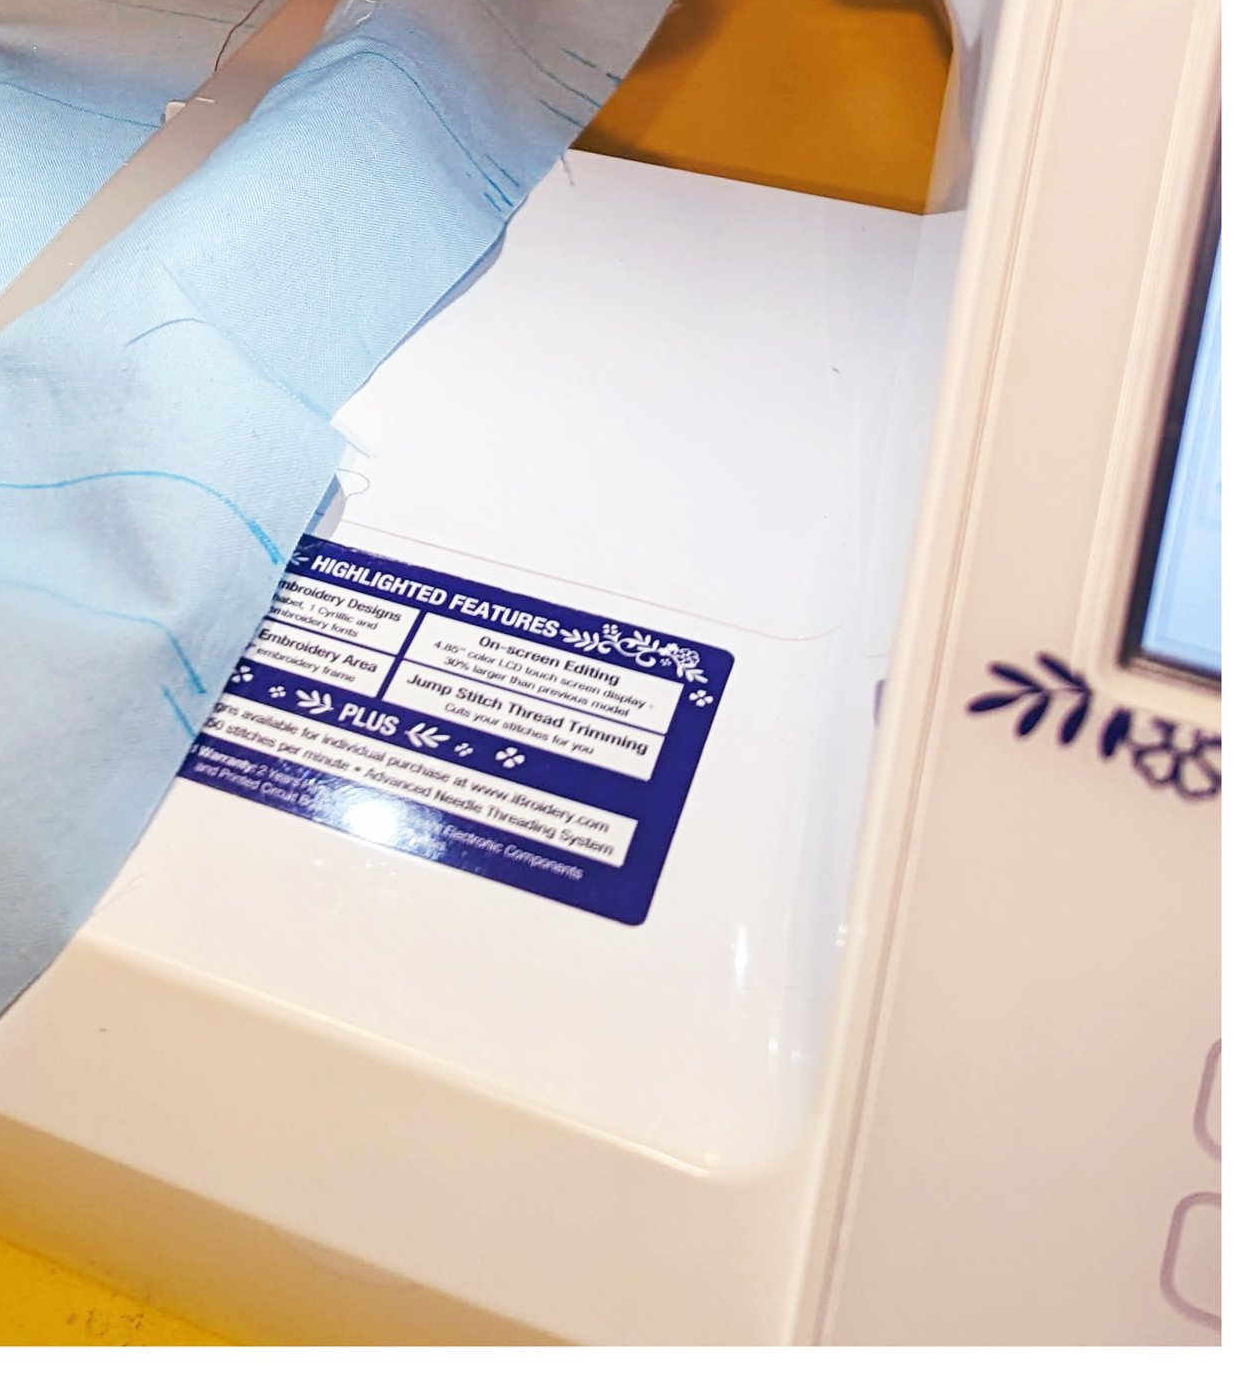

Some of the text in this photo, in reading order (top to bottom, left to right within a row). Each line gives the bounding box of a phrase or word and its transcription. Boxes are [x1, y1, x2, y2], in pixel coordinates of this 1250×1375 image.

[269, 606, 359, 638] mbroidery fonts
[278, 580, 402, 623] mbroidery Designs
[310, 555, 561, 638] HIGHLIGHTED FEATURES
[318, 604, 354, 624] Cyrillic
[356, 618, 378, 631] and
[256, 647, 356, 683] embroidery frame
[258, 628, 378, 673] Embroidery Area
[478, 635, 621, 687] On-screen Editing
[467, 647, 497, 665] color
[498, 656, 523, 673] LCD
[525, 665, 557, 684] touch
[559, 677, 601, 695] screen
[602, 687, 646, 710] display
[472, 663, 507, 684] larger
[509, 675, 535, 690] than
[537, 683, 589, 707] previous
[591, 697, 630, 718] model
[338, 703, 400, 736] PLUS
[406, 673, 649, 756] Jump Stitch Thread Trimming
[444, 701, 595, 755] Cuts your stitches for you
[219, 764, 260, 790] Printed
[226, 724, 276, 748] stitches
[277, 741, 300, 758] per
[302, 747, 350, 772] minute
[364, 767, 432, 798] Advanced
[434, 789, 483, 814] Needle
[486, 804, 556, 839] Threading
[560, 828, 615, 857] System
[241, 709, 298, 735] available
[300, 726, 320, 741] for
[322, 732, 386, 762] individual
[387, 754, 451, 782] purchase
[452, 772, 469, 788] at
[471, 780, 610, 834] www.iBroidery.com
[443, 824, 504, 855] Electronic
[504, 843, 584, 881] Components
